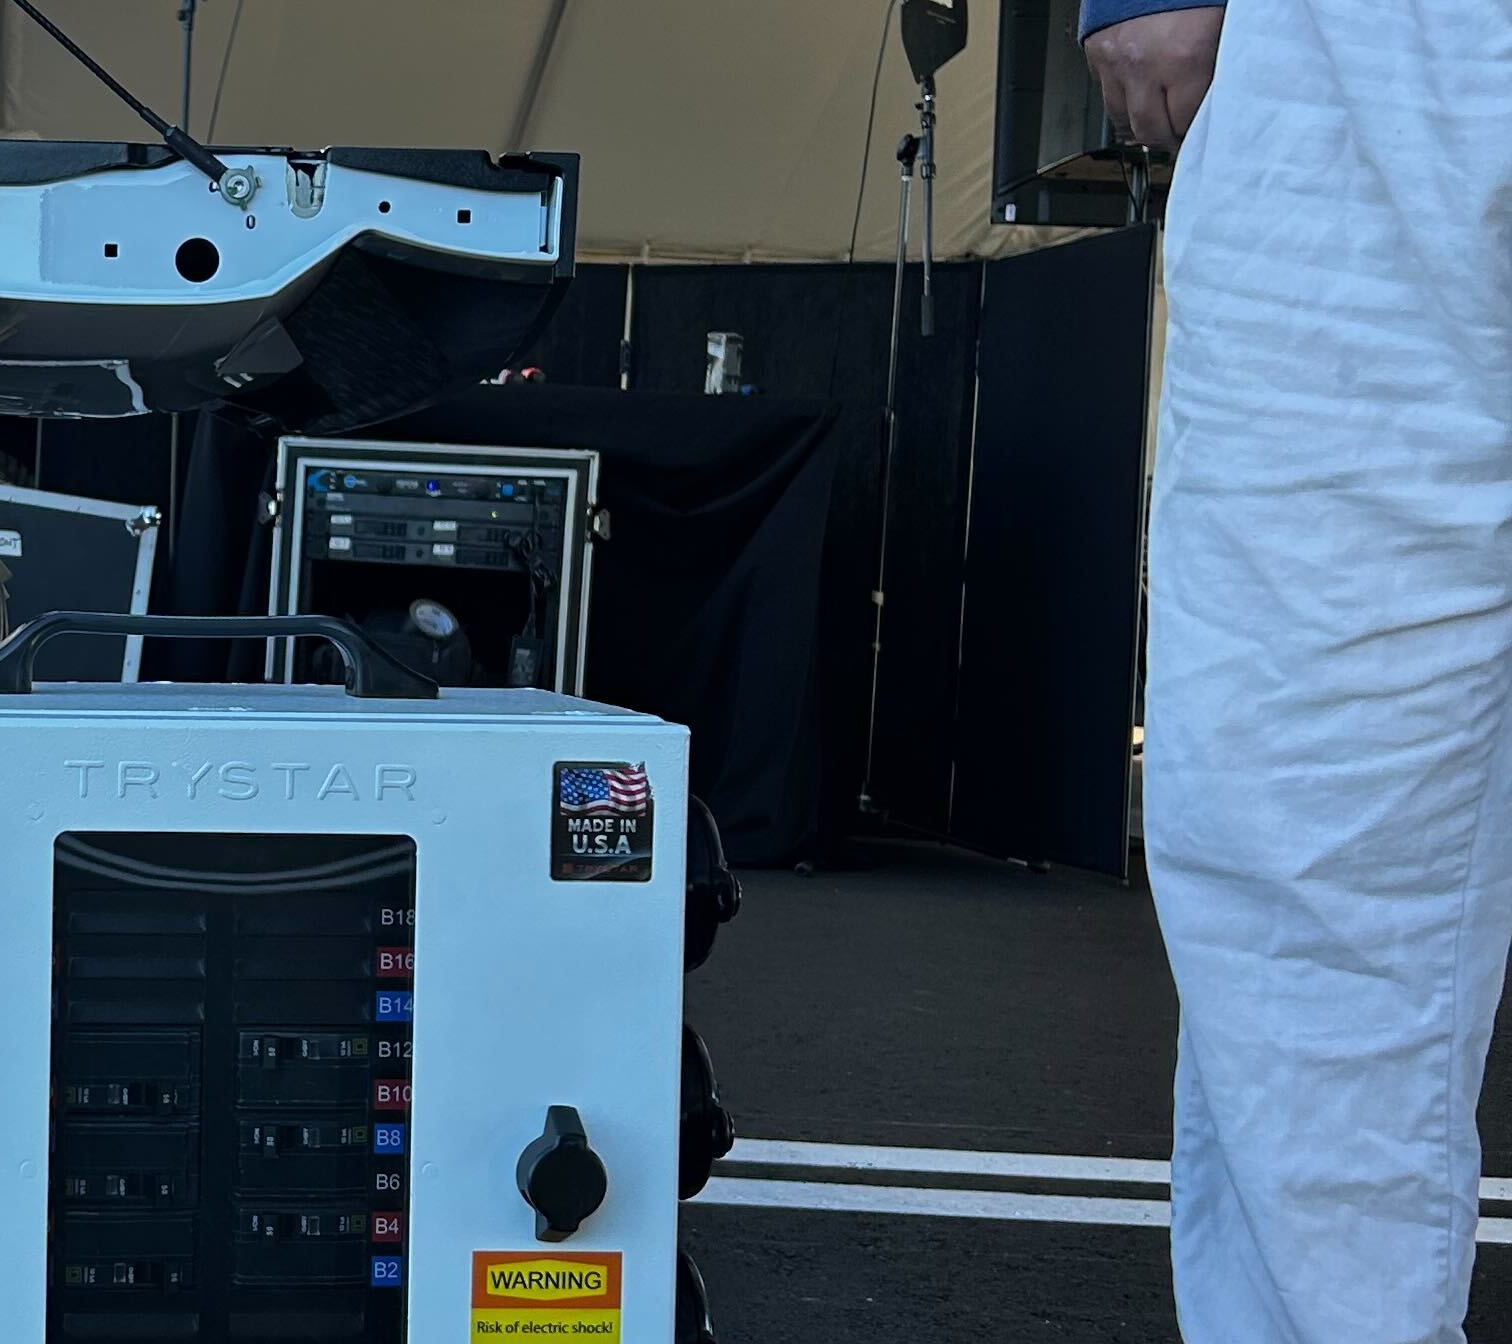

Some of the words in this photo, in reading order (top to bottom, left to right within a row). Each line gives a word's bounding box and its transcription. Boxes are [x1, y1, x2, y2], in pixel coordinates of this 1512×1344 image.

[64, 759, 417, 801] TRYSTAR
[568, 818, 614, 833] MADE
[620, 818, 636, 833] IN
[381, 908, 416, 926] B18
[380, 953, 415, 970] B16
[378, 997, 414, 1014] B14
[378, 1041, 413, 1057] B12
[376, 1129, 401, 1146] B8
[376, 1173, 400, 1190] B6
[375, 1218, 399, 1234] B4
[374, 1261, 398, 1278] B2
[490, 1270, 602, 1290] WARNING
[476, 1320, 502, 1334] Risk
[505, 1320, 520, 1334] of
[521, 1321, 569, 1334] electric
[572, 1321, 613, 1334] shock!
